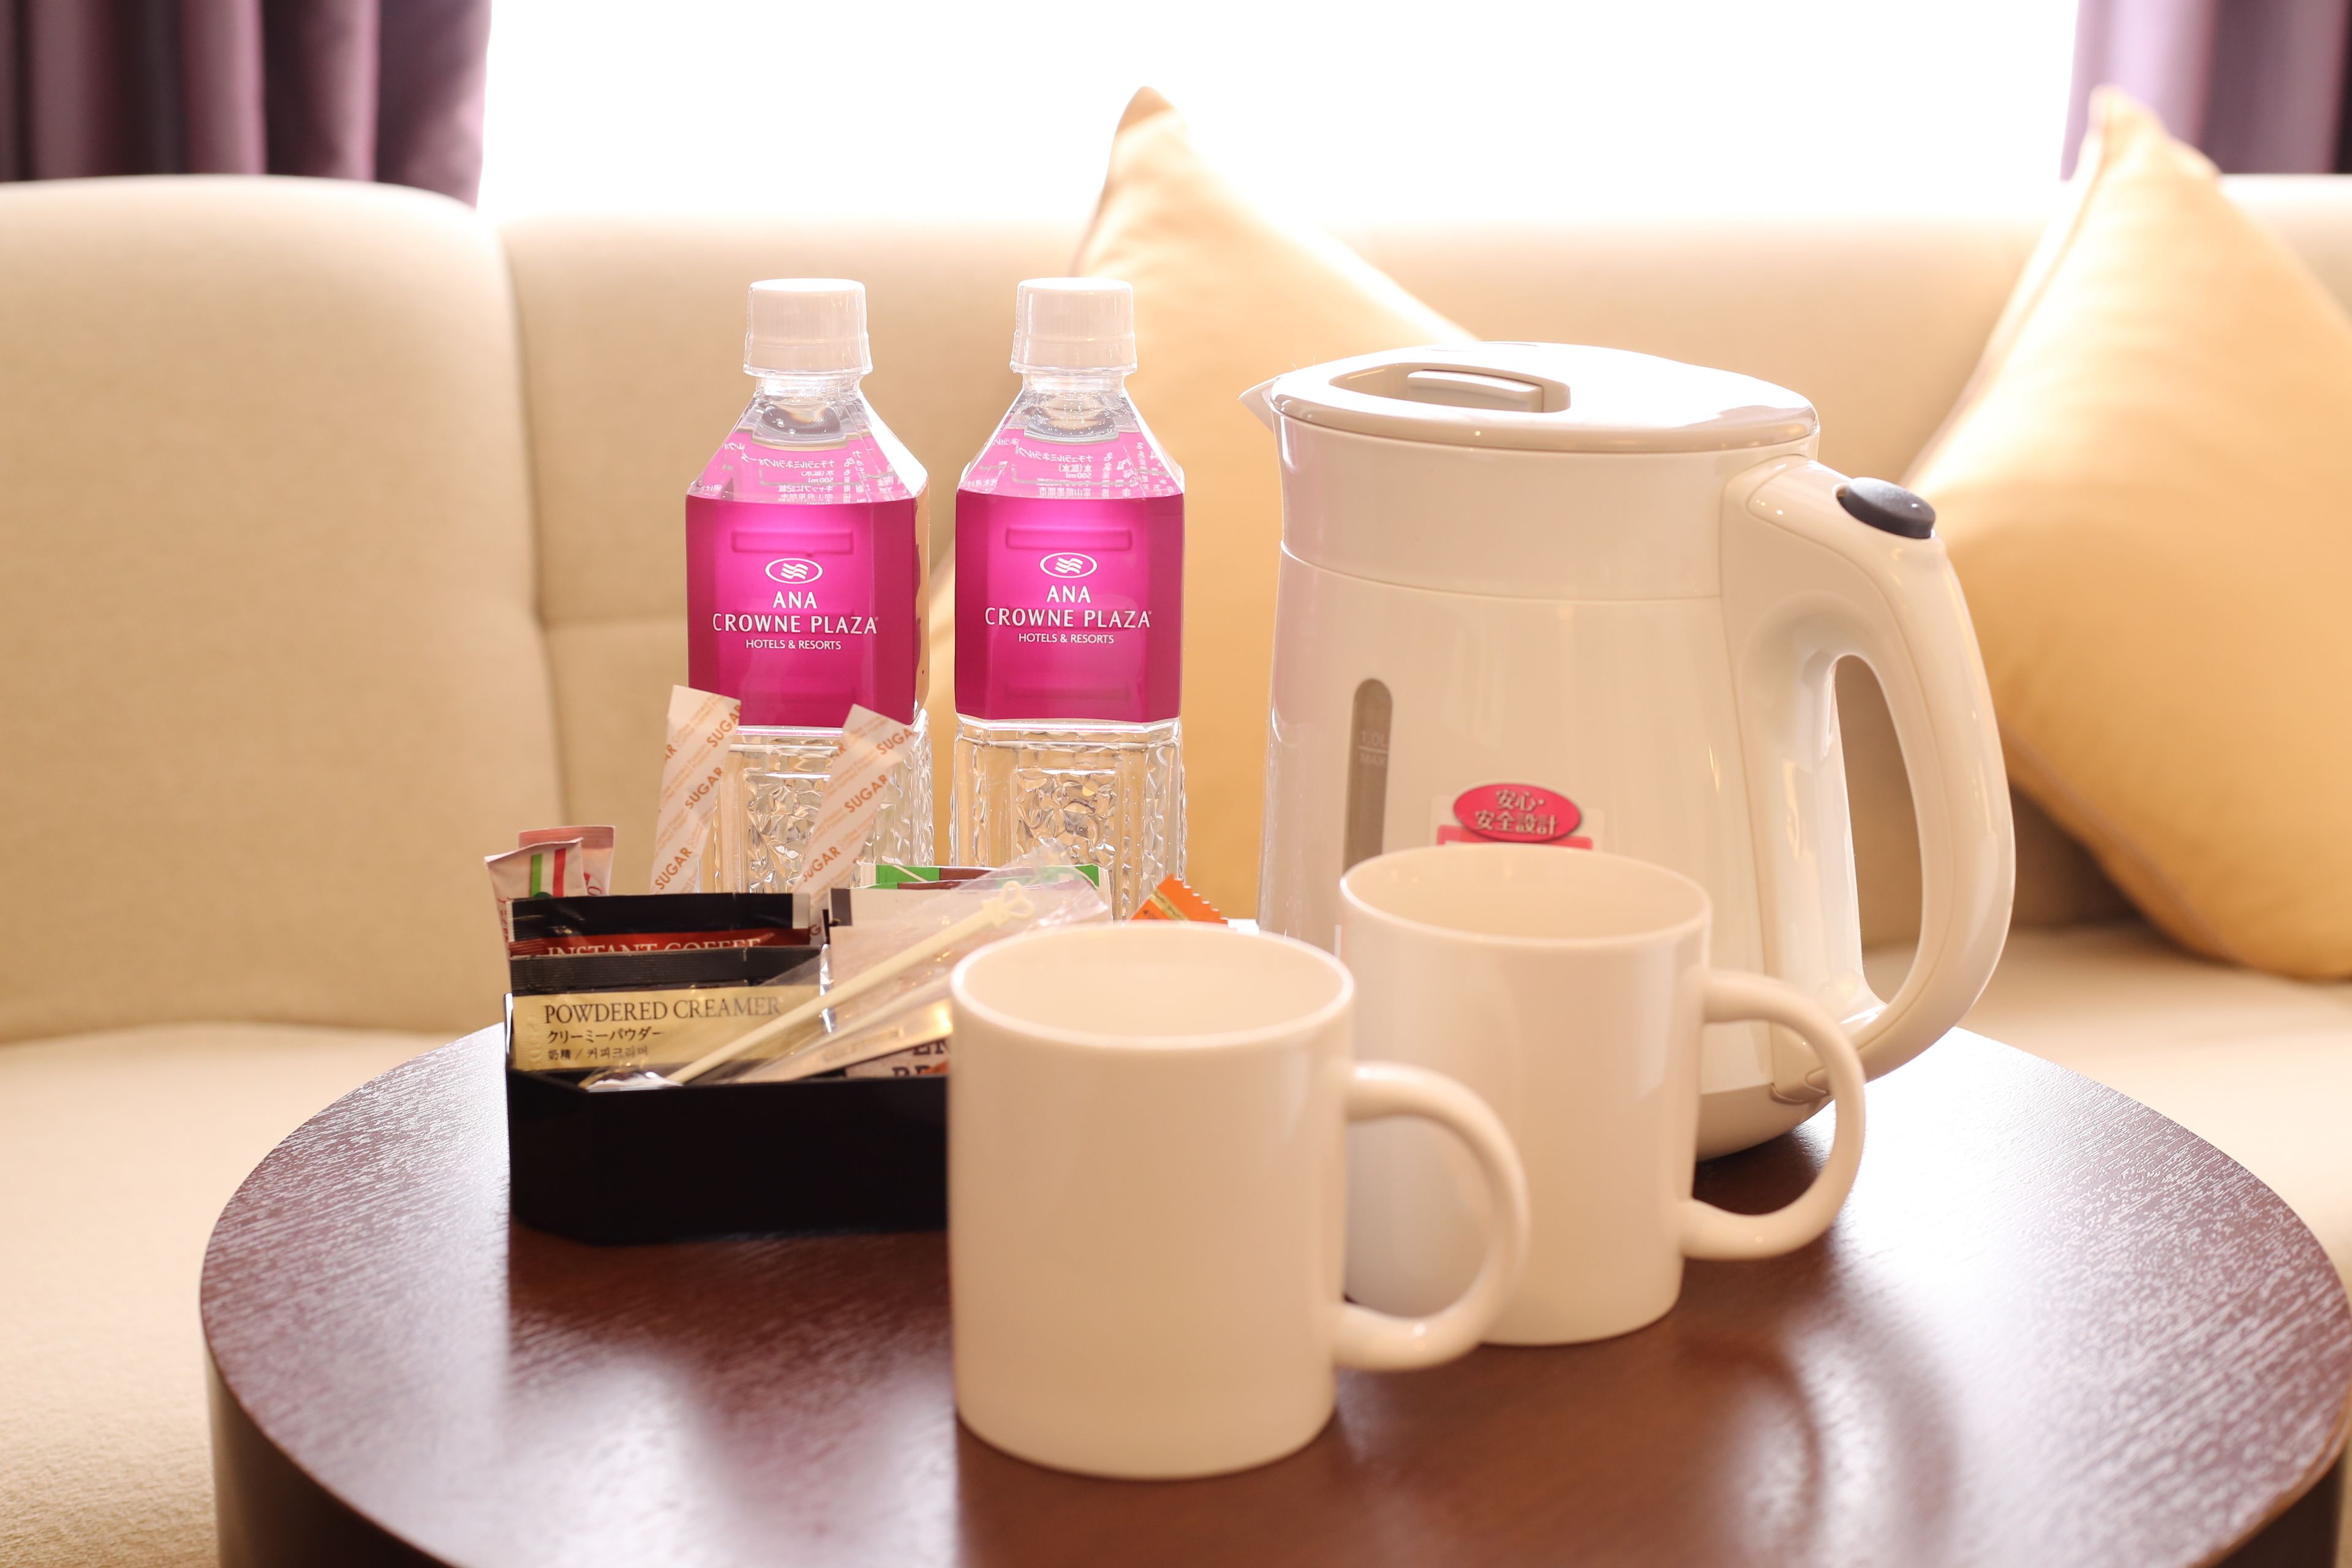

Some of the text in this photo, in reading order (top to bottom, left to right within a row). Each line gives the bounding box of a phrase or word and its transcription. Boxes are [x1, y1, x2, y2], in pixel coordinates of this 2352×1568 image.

[772, 591, 818, 609] ANA
[1046, 585, 1091, 603] ANA
[712, 613, 801, 633] CROWNE
[985, 607, 1074, 627] CROWNE
[746, 639, 842, 650] HOTELS & RESORTS
[1019, 633, 1115, 644] HOTELS & RESORTS
[685, 766, 723, 809] SUGAR
[844, 774, 888, 813] SUGAR
[1474, 809, 1557, 837] 安全設計
[655, 846, 693, 891] SUGAR
[544, 997, 782, 1024] POWDERED CREAMER
[548, 1026, 662, 1044] クリーミーパウダー
